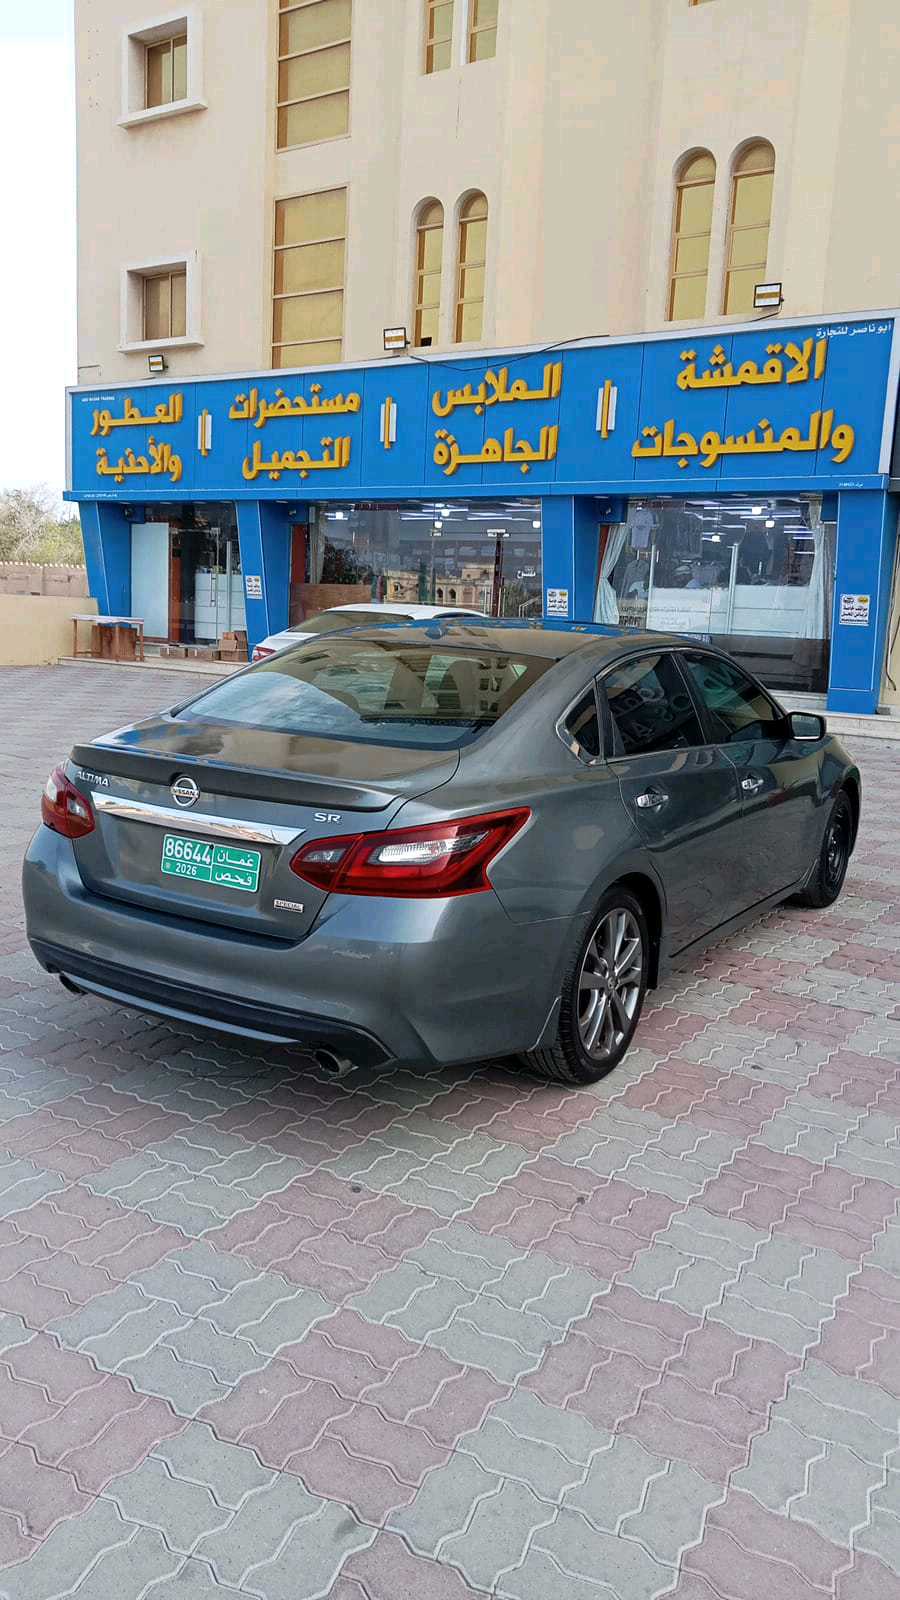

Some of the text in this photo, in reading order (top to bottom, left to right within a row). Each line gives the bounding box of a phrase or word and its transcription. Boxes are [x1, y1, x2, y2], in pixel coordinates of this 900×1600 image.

[816, 325, 849, 338] للتجارة
[849, 322, 875, 336] ناصر
[676, 336, 828, 390] الاقمشة
[228, 383, 361, 428] مستحضرات
[432, 362, 563, 417] الملابس
[91, 392, 184, 436] العطور
[433, 425, 559, 475] الجاهزة
[631, 408, 855, 468] والمنسوجات
[96, 435, 183, 483] والأحذية
[242, 436, 351, 480] التجميل
[77, 771, 110, 786] ALTIMA
[171, 786, 199, 798] NISSAN
[314, 812, 342, 823] SR
[165, 838, 212, 865] 86644
[175, 862, 198, 876] 2026
[215, 871, 253, 886] فحص
